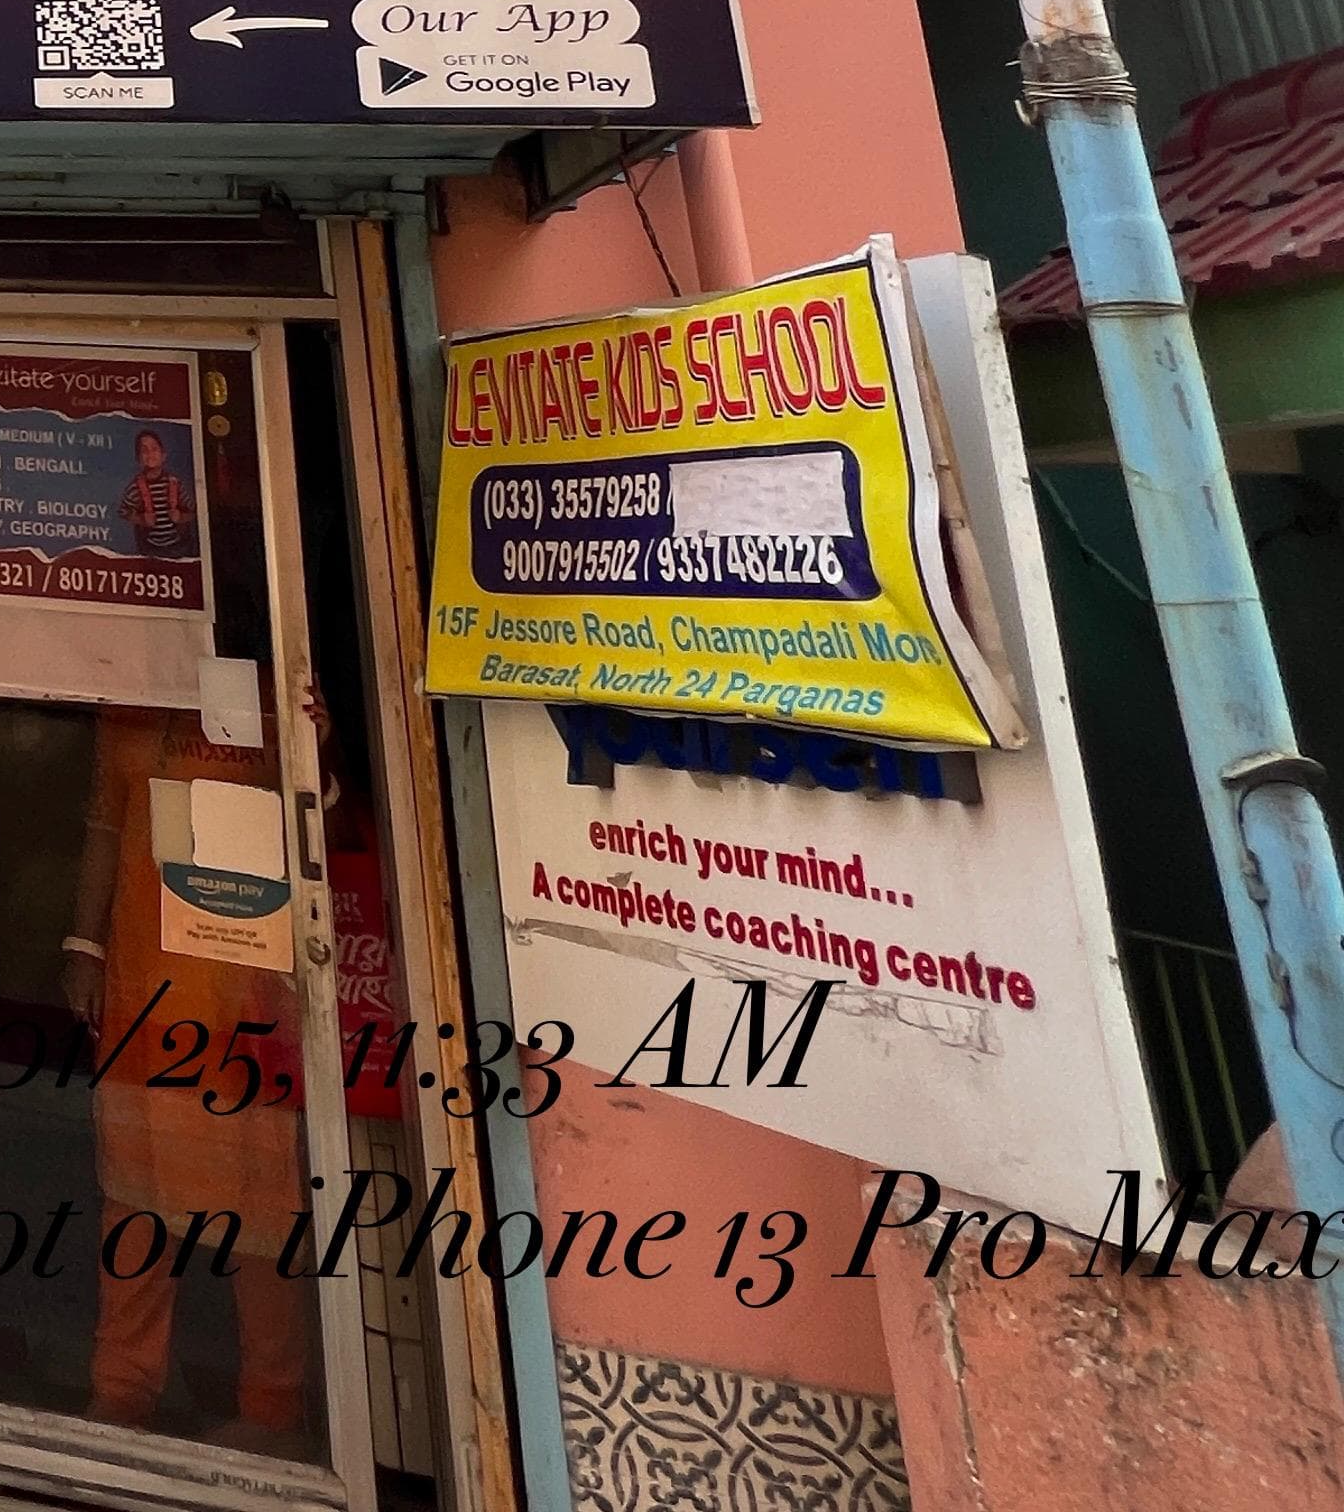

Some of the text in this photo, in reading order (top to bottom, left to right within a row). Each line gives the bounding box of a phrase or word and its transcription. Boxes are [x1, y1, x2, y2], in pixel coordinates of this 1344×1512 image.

[381, 2, 611, 44] Our App
[443, 53, 529, 67] GET IT ON
[445, 71, 631, 97] Google Play
[63, 86, 144, 99] SCAN ME
[448, 298, 887, 447] LEVITATE KIDS SCHOOL
[0, 429, 54, 444] MEDIUM
[484, 472, 660, 530] (033) 35579258
[60, 567, 182, 599] 8017175938
[503, 535, 844, 584] 9007915502 9337482226
[436, 605, 856, 664] 15F Jessore Road, Champadali
[479, 656, 885, 717] Barasat, North 24 Parganas
[588, 819, 914, 908] enrich your mind...
[532, 862, 1037, 1011] A complete coaching centre
